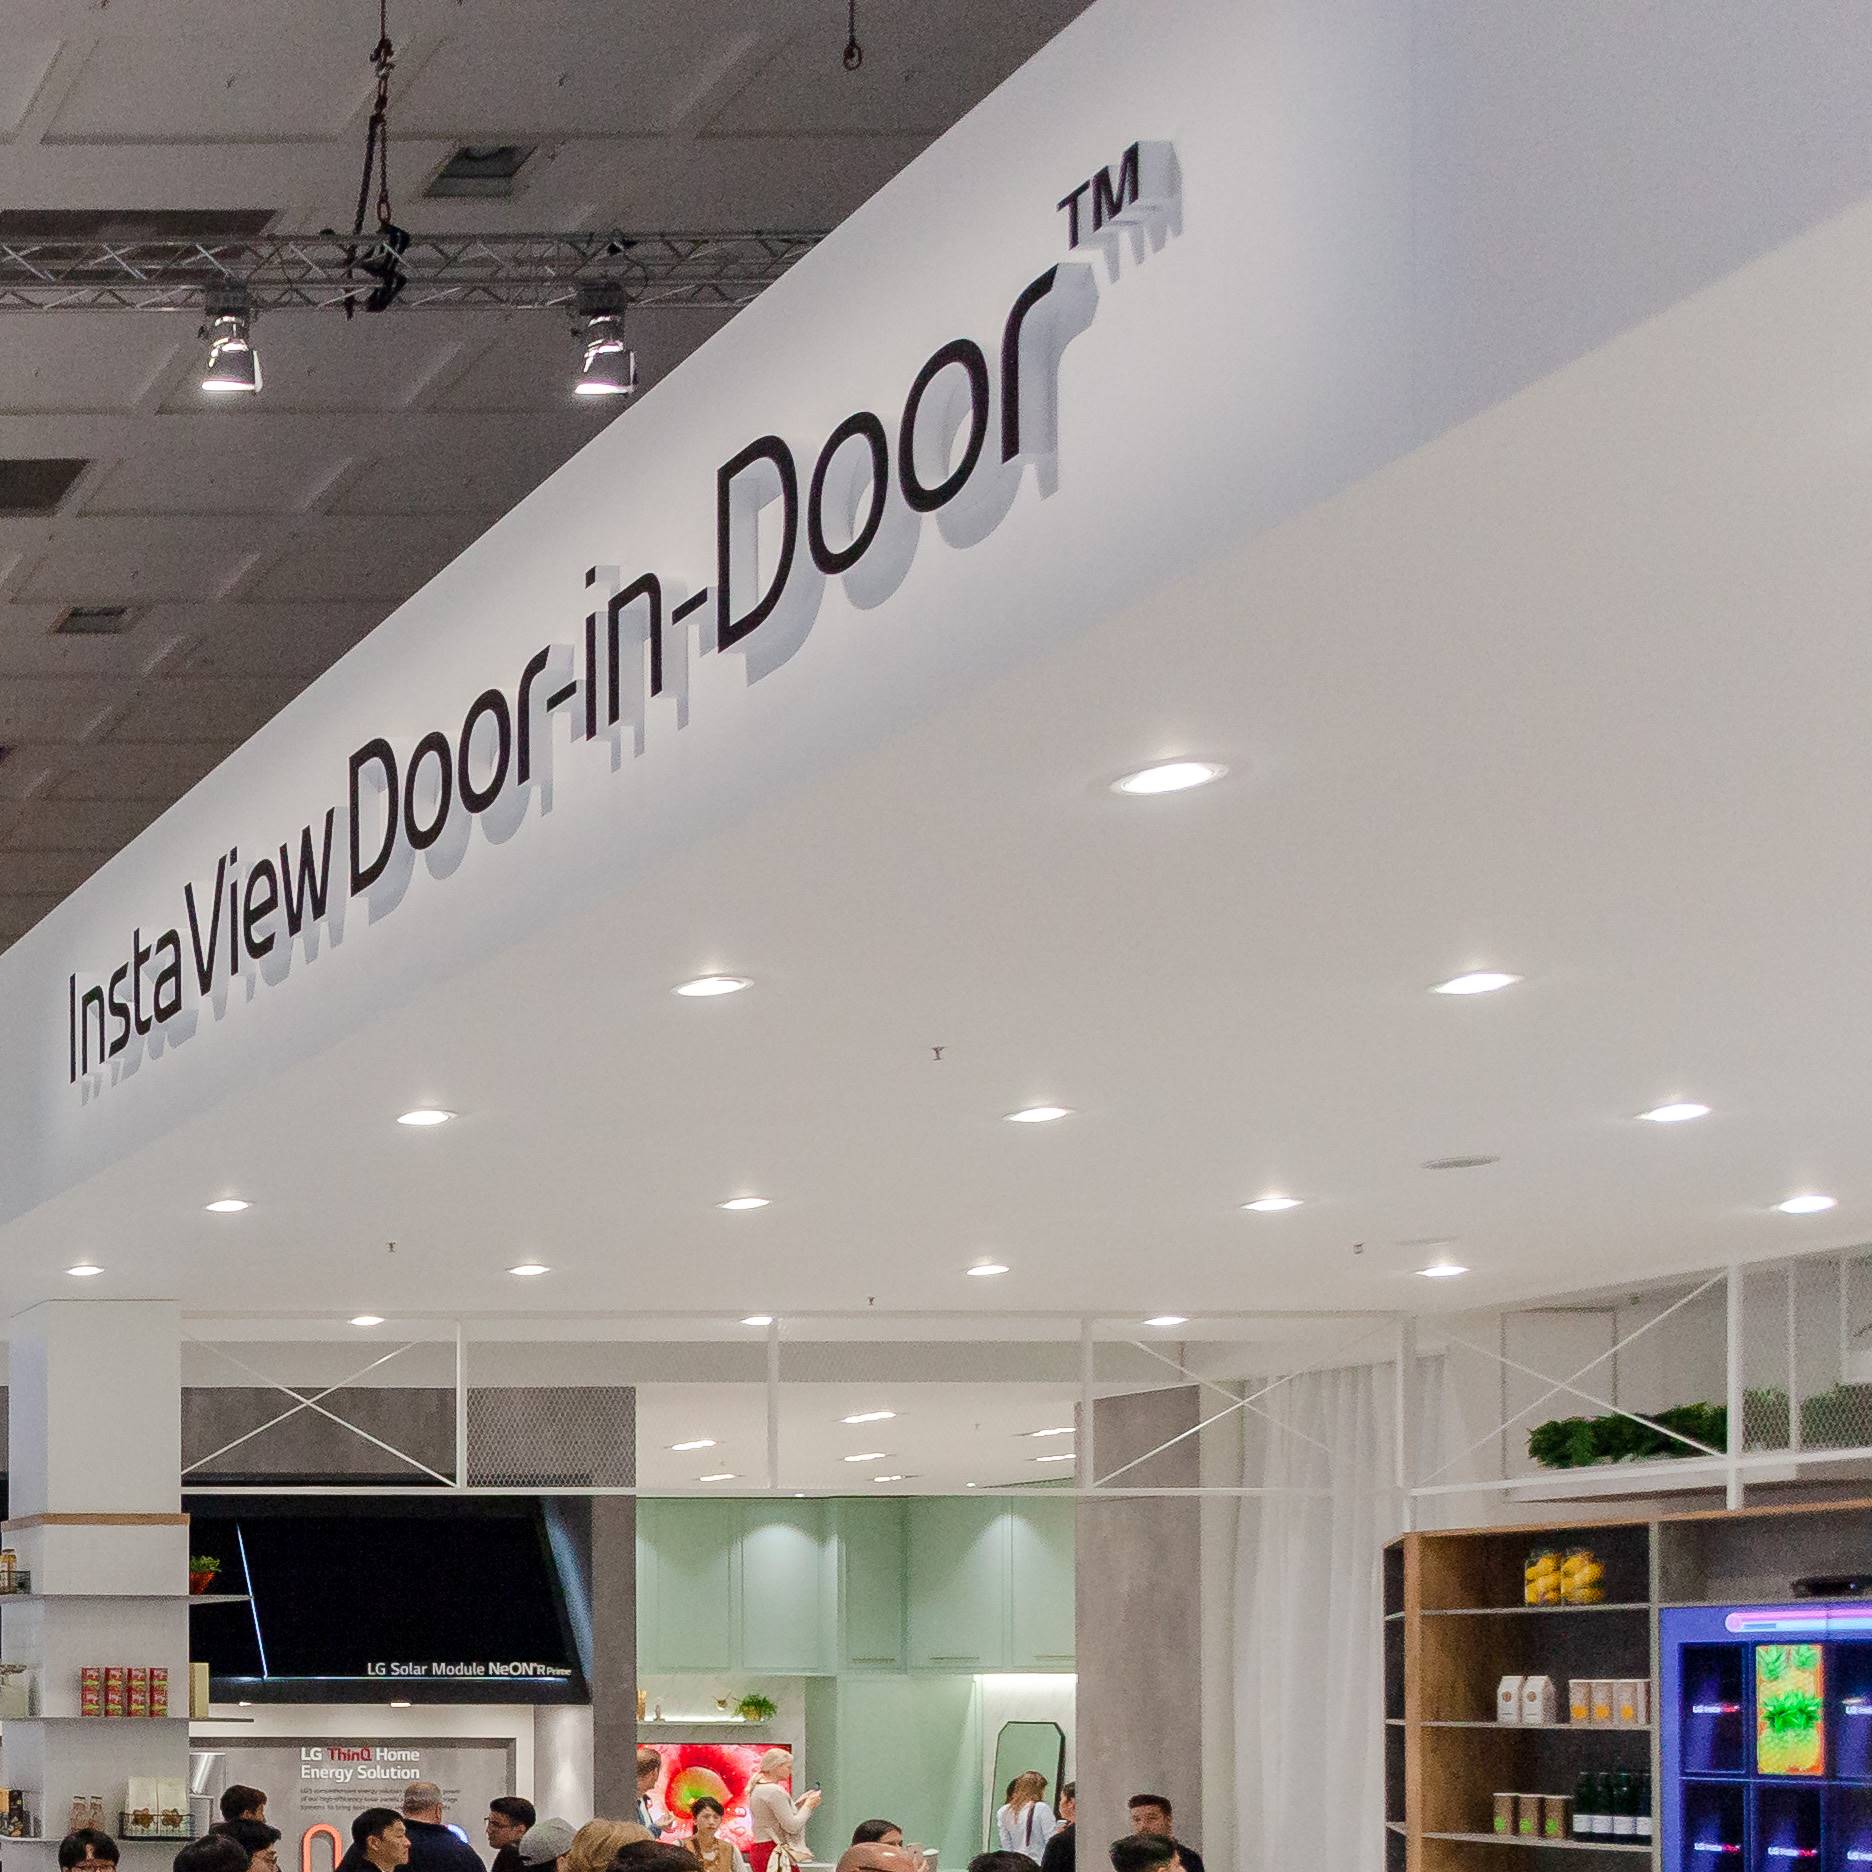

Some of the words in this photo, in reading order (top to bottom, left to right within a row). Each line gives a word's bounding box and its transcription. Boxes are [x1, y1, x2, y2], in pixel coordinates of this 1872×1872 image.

[69, 806, 336, 1084] InstaView
[366, 1662, 387, 1676] LG
[390, 1662, 428, 1676] Solar
[431, 1662, 486, 1676] Module
[300, 1747, 323, 1762] LG
[327, 1747, 373, 1763] ThinQ
[375, 1748, 421, 1762] Home
[300, 1765, 354, 1783] Energy
[356, 1765, 421, 1780] Solution
